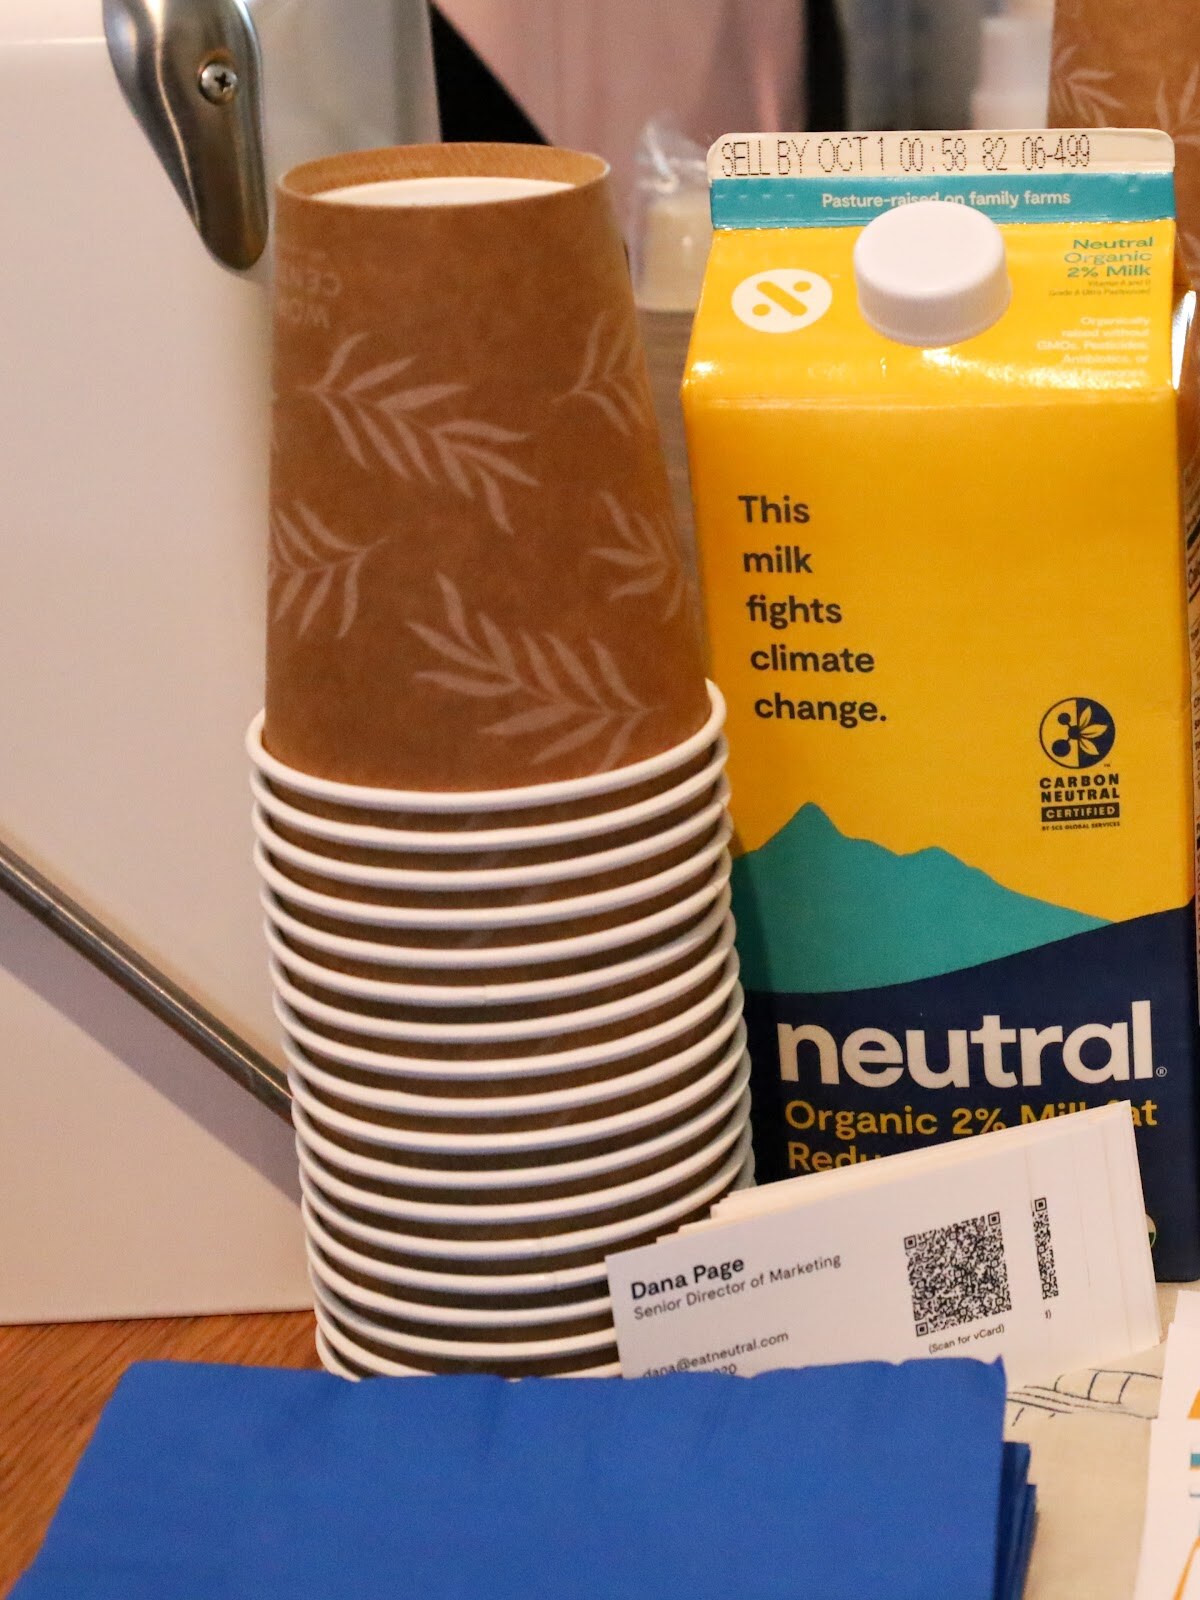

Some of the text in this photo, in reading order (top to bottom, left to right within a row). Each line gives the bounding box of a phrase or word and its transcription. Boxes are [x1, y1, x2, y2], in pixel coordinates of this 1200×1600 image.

[721, 141, 771, 176] SELL
[778, 138, 810, 175] BY
[818, 136, 868, 172] OCT
[877, 136, 885, 171] 1
[982, 136, 1008, 171] 82
[1022, 134, 1090, 170] 06-499
[821, 190, 1071, 208] Pasture-raised on family farms
[1072, 236, 1153, 249] Neutral
[1064, 250, 1153, 265] Organic
[1067, 264, 1151, 278] 2% Milk
[738, 495, 810, 523] This
[743, 545, 813, 573] milk
[746, 594, 842, 630] fights
[750, 644, 875, 673] climate
[754, 692, 887, 728] change.
[1040, 773, 1119, 789] CARBON
[1041, 787, 1120, 803] NEUTRAL
[1045, 805, 1116, 819] CERTIFIED
[776, 1000, 1153, 1089] neutral
[784, 1099, 939, 1141] Organic
[951, 1106, 1007, 1136] 2%
[630, 1258, 745, 1300] Dana Page
[633, 1254, 842, 1321] Senior Director of Marketing
[928, 1323, 1006, 1355] (Scan for vCard)
[642, 1331, 790, 1378] dana@eatneutral.com
